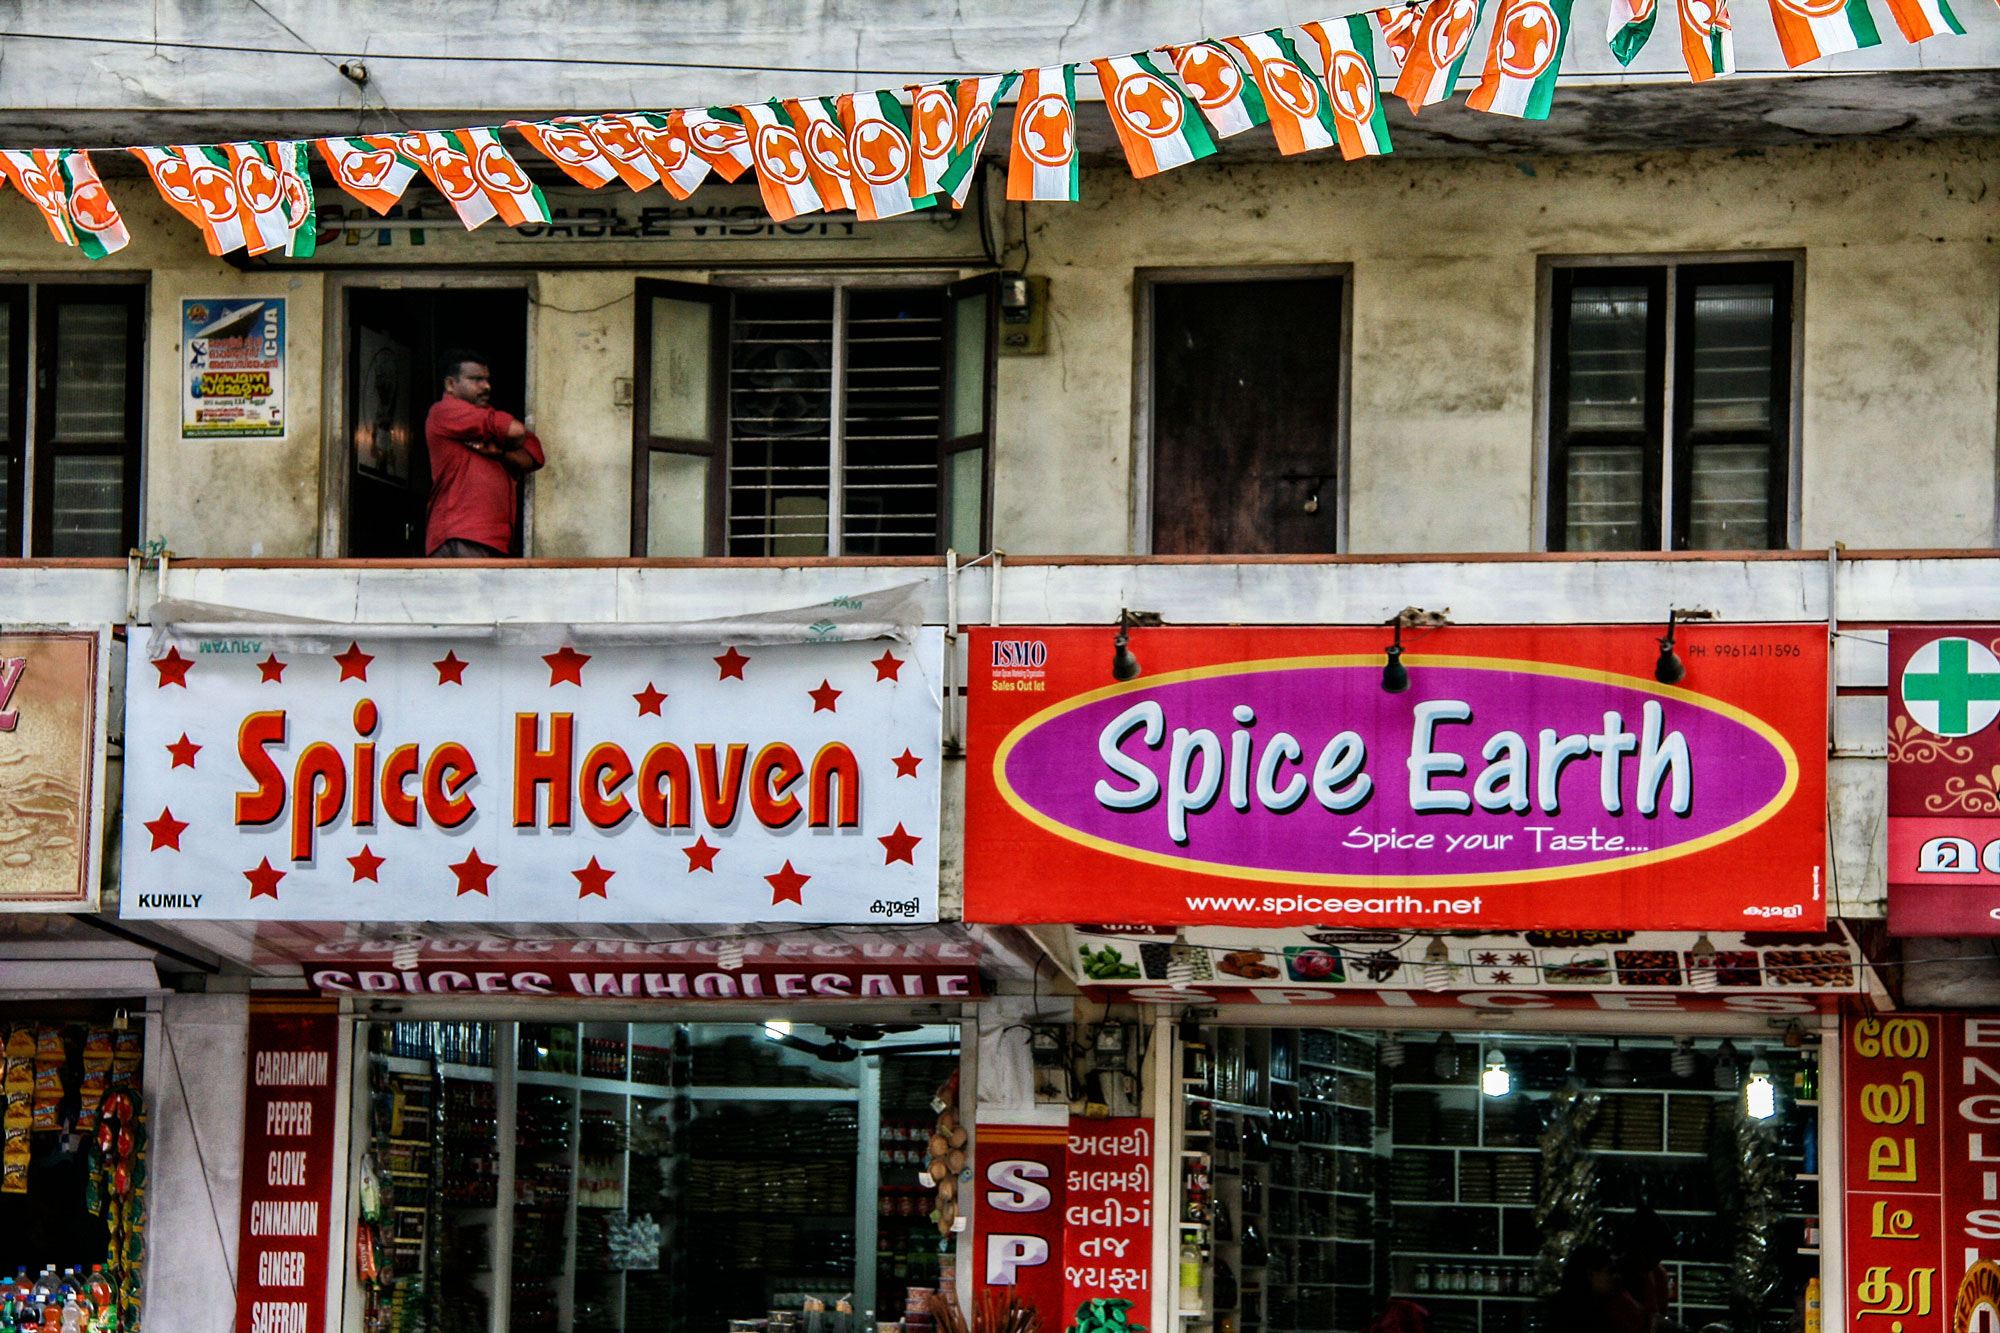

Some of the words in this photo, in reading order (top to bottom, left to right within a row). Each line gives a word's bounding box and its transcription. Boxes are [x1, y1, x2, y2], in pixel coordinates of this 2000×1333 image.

[264, 307, 278, 358] COA
[992, 640, 1047, 667] ISMO
[1714, 644, 1800, 657] 9961411596
[992, 680, 1015, 691] Sales
[235, 697, 478, 861] Spice
[512, 711, 860, 829] Heaven
[1094, 699, 1373, 842] Spice
[1406, 699, 1692, 814] Earth
[1342, 826, 1435, 852] Spice
[1445, 833, 1513, 852] your
[138, 893, 203, 908] KUMILY
[869, 896, 920, 918] കുമളി
[1185, 894, 1482, 915] www.spiceearth.net
[1742, 904, 1803, 919] കുമളി
[255, 1052, 328, 1086] CARDAMOM
[266, 1101, 312, 1136] PEPPER
[267, 1151, 306, 1186] CLOVE
[251, 1201, 318, 1236] CINNAMON
[1079, 1237, 1130, 1258] તજ
[259, 1251, 304, 1286] GINGER
[251, 1301, 308, 1333] SAFFRON
